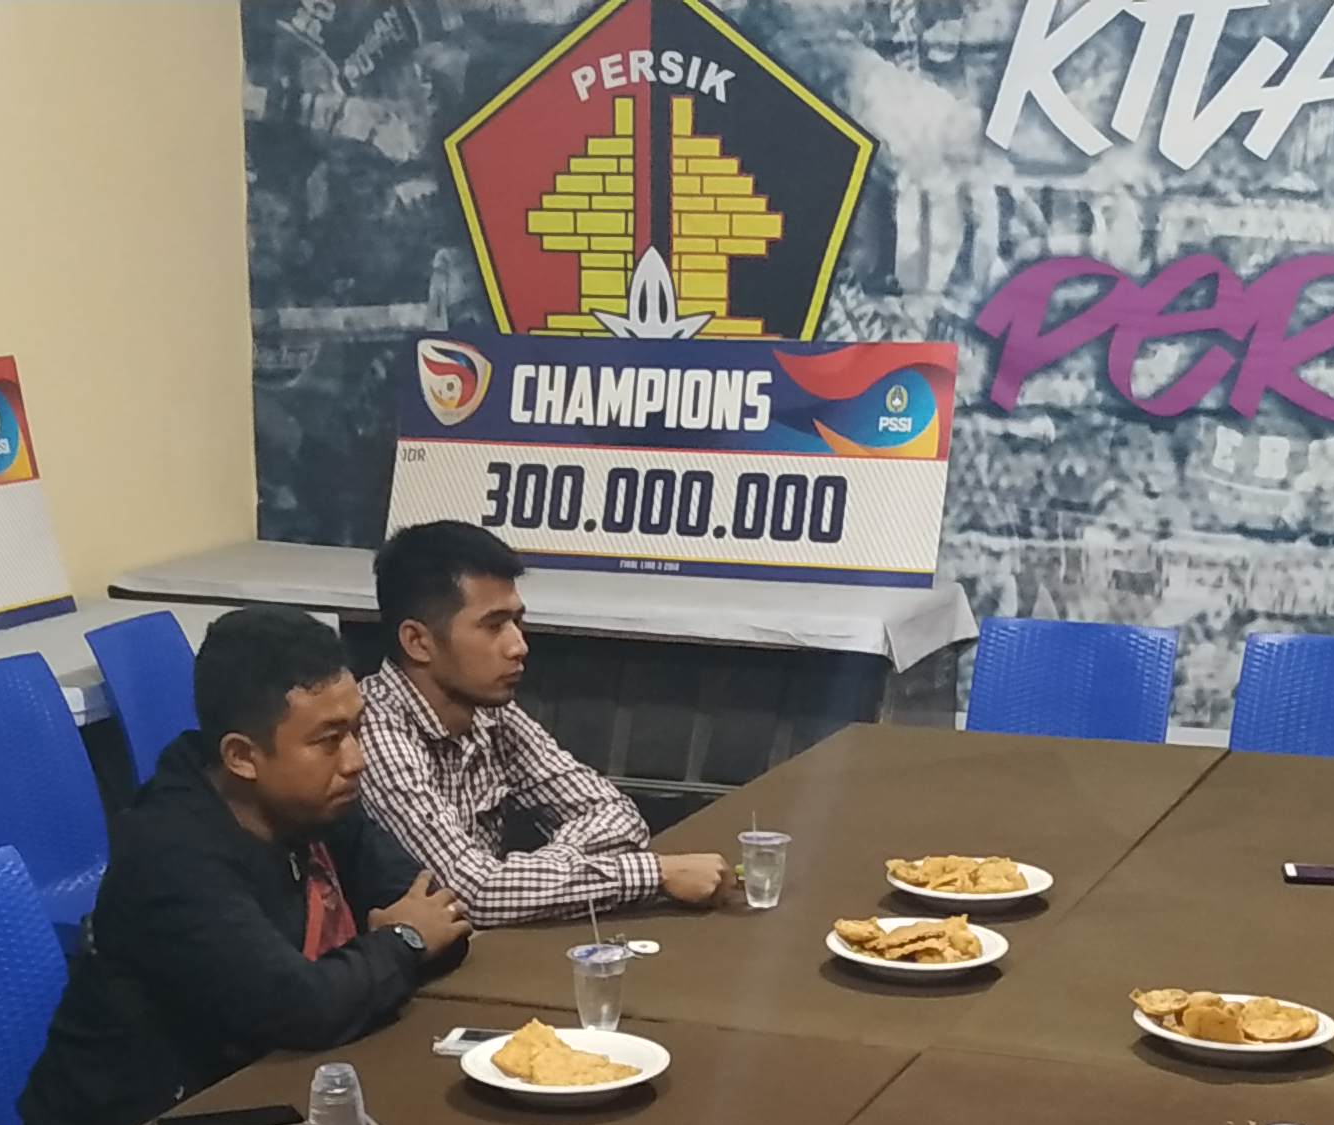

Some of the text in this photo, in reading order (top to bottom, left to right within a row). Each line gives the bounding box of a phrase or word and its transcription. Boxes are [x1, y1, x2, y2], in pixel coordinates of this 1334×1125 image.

[571, 50, 736, 103] PERSIK
[510, 363, 772, 432] CHAMPIONS
[878, 416, 913, 433] PSSI
[400, 448, 427, 463] IDR
[481, 462, 847, 544] 300.000.000
